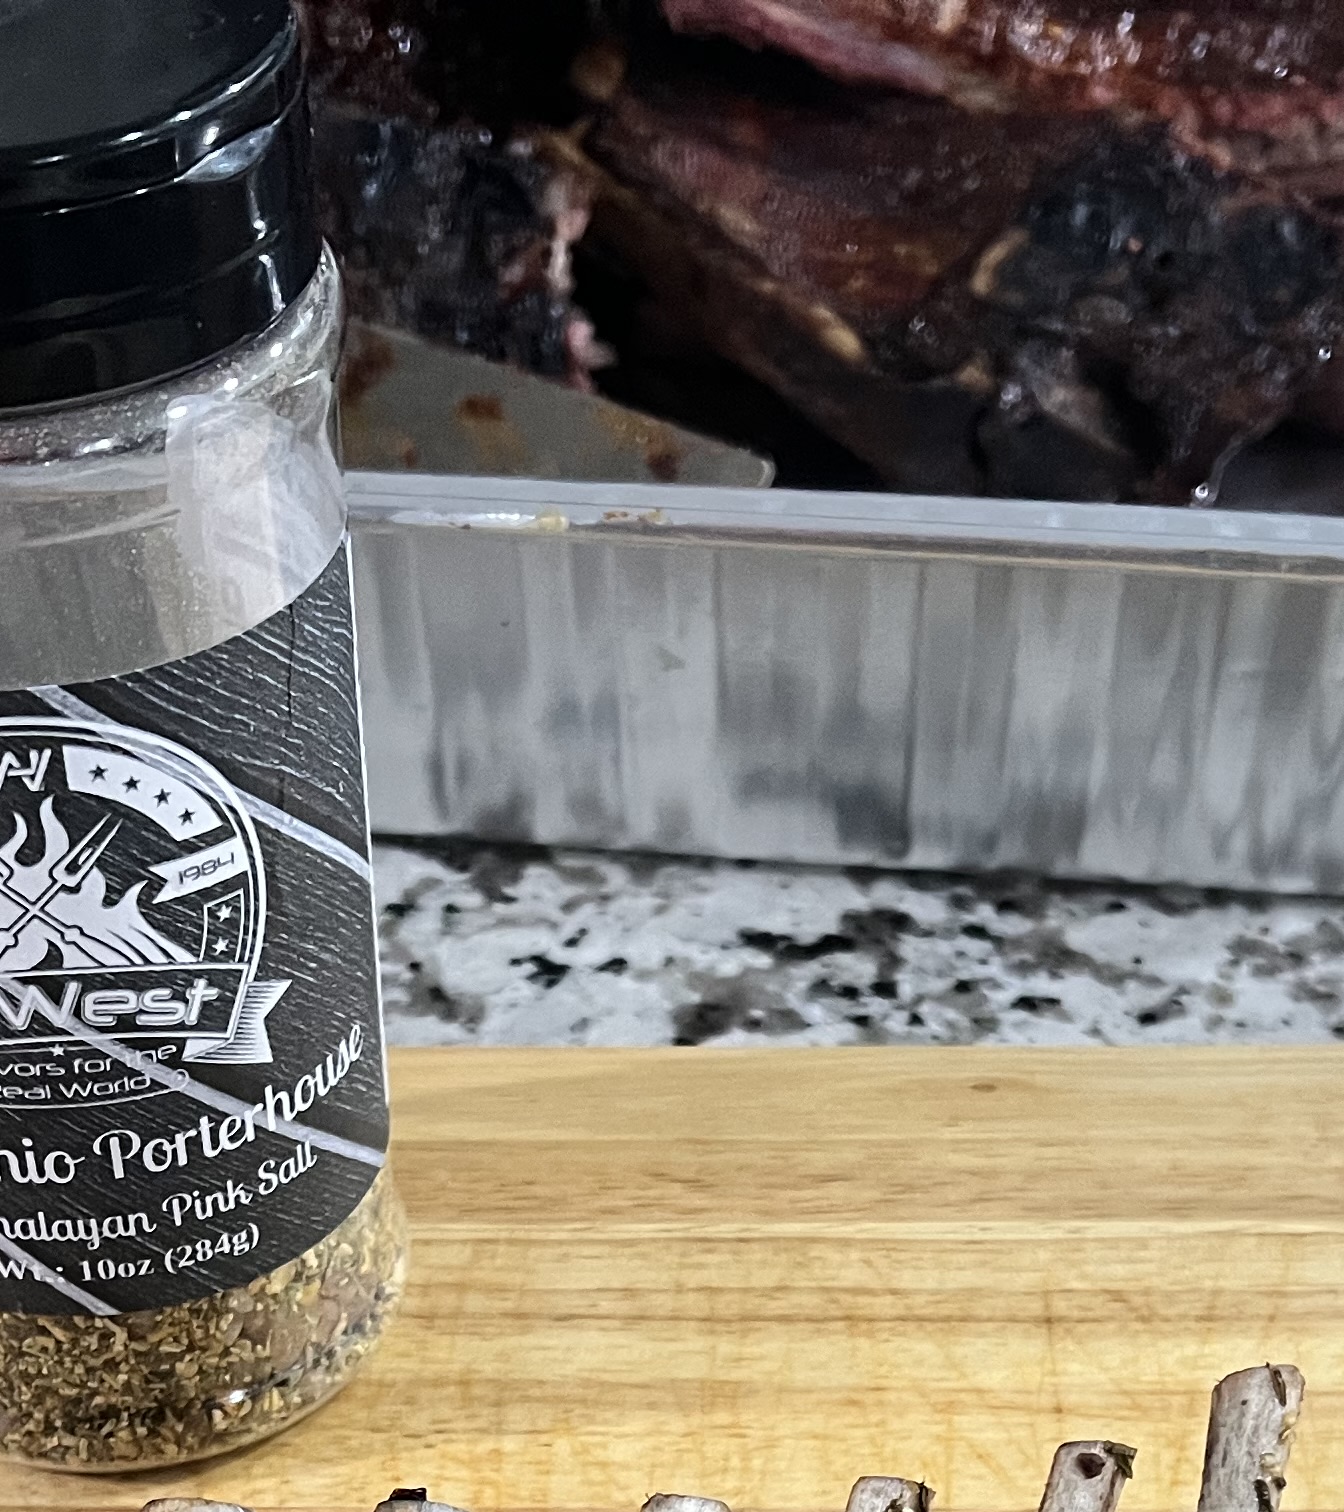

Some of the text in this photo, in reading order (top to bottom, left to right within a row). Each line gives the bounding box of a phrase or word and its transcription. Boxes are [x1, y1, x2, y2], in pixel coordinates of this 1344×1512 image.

[178, 851, 235, 885] 1984
[58, 1072, 152, 1099] World
[73, 1055, 113, 1075] for
[92, 1023, 365, 1180] Porterhouse
[161, 1179, 254, 1227] Pink
[257, 1140, 319, 1196] Salt
[78, 1257, 155, 1282] 10oz
[163, 1221, 261, 1275] (284g)
